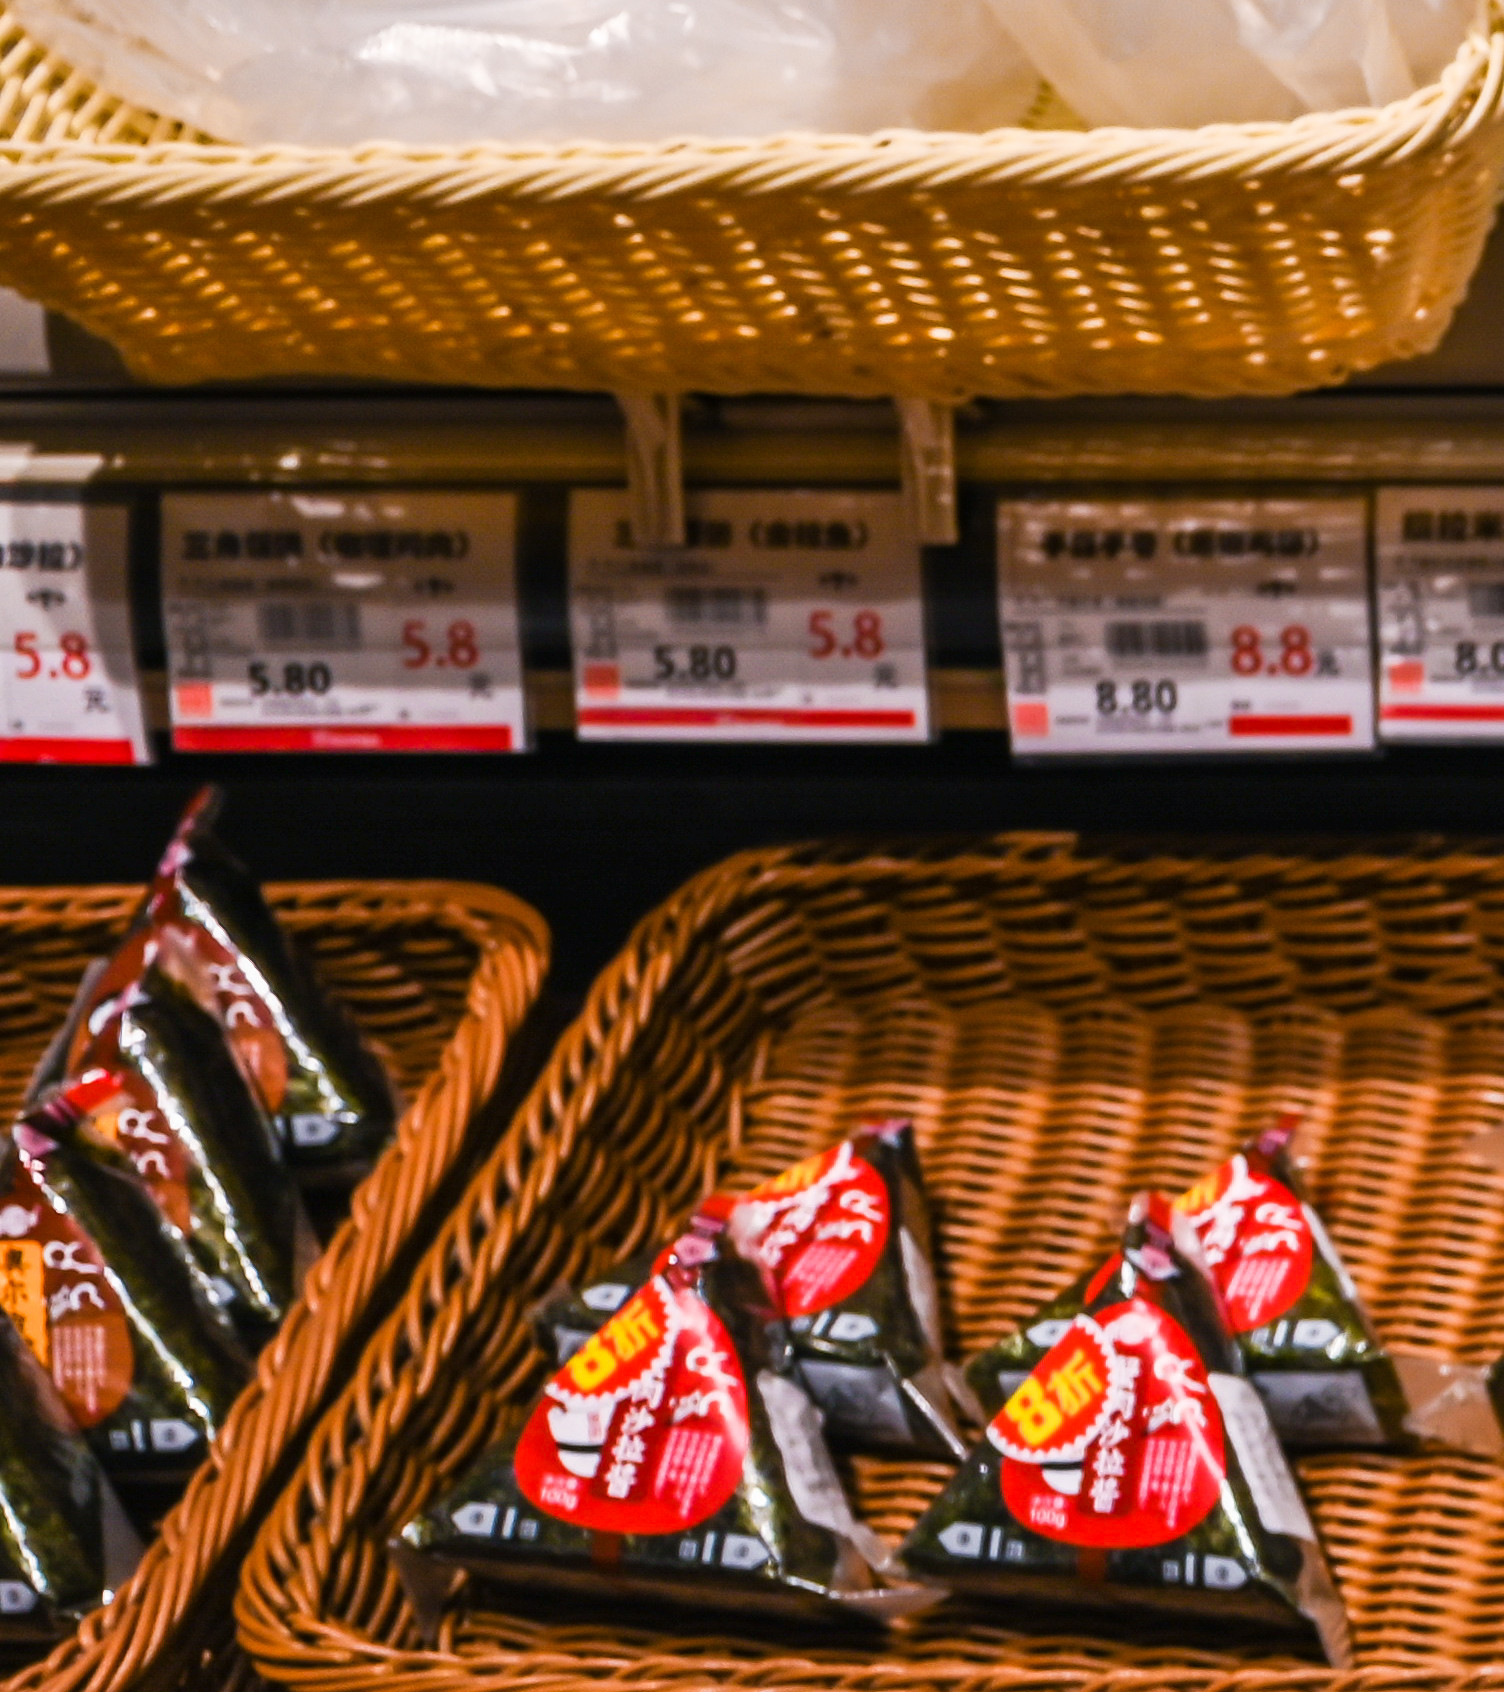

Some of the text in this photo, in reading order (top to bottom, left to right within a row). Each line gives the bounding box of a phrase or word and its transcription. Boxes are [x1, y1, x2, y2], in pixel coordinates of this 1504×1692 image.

[13, 631, 92, 681] 5.8
[402, 620, 481, 669] 5.8
[807, 608, 886, 661] 5.8
[1230, 625, 1314, 677] 8.8
[248, 661, 333, 695] 5.80
[654, 646, 737, 682] 5.80
[1096, 680, 1179, 715] 8.80
[1004, 1348, 1103, 1446] 8折
